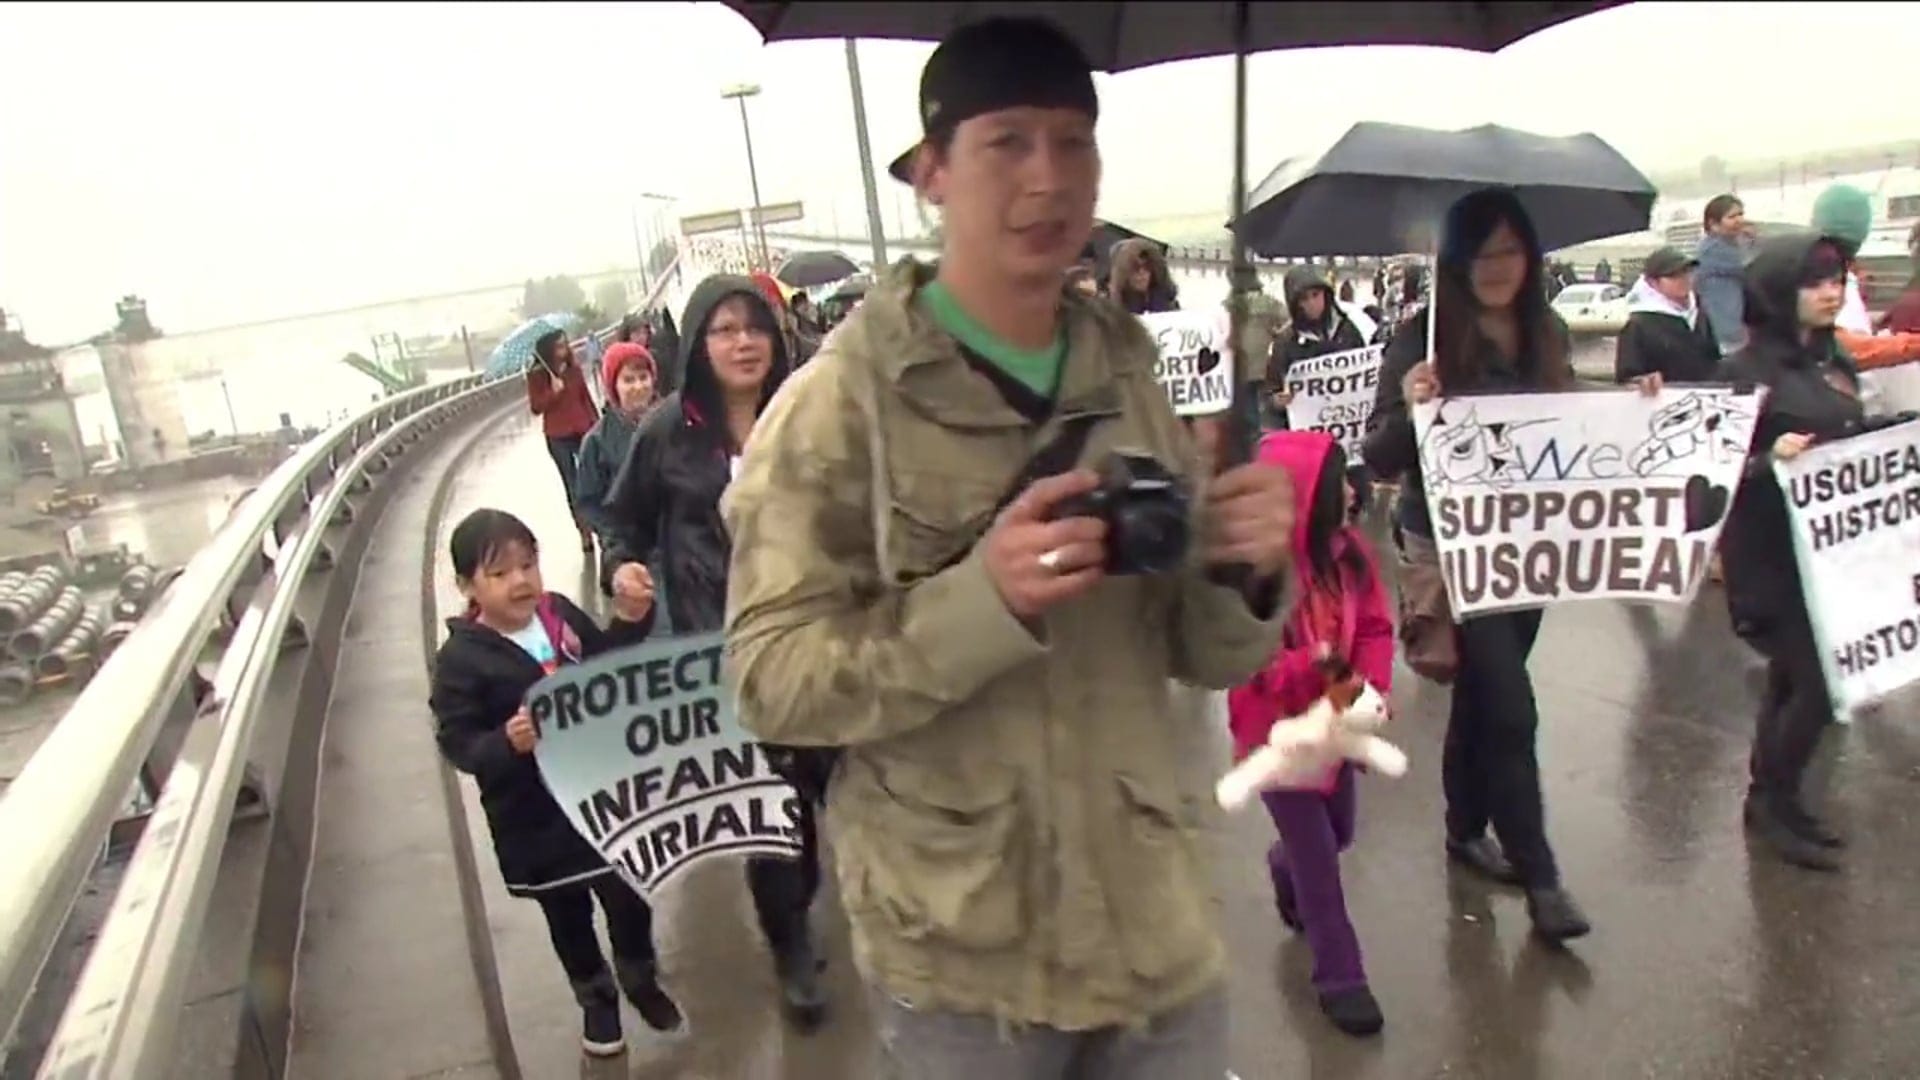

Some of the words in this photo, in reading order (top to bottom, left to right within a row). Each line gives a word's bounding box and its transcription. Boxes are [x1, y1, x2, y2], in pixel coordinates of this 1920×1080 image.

[1289, 366, 1379, 397] PROTE
[1515, 437, 1624, 482] We
[1438, 486, 1684, 540] SUPPORT
[1834, 614, 1920, 677] HISTO
[529, 644, 726, 740] PROTECT
[624, 697, 721, 758] OUR
[612, 797, 801, 882] URIALS
